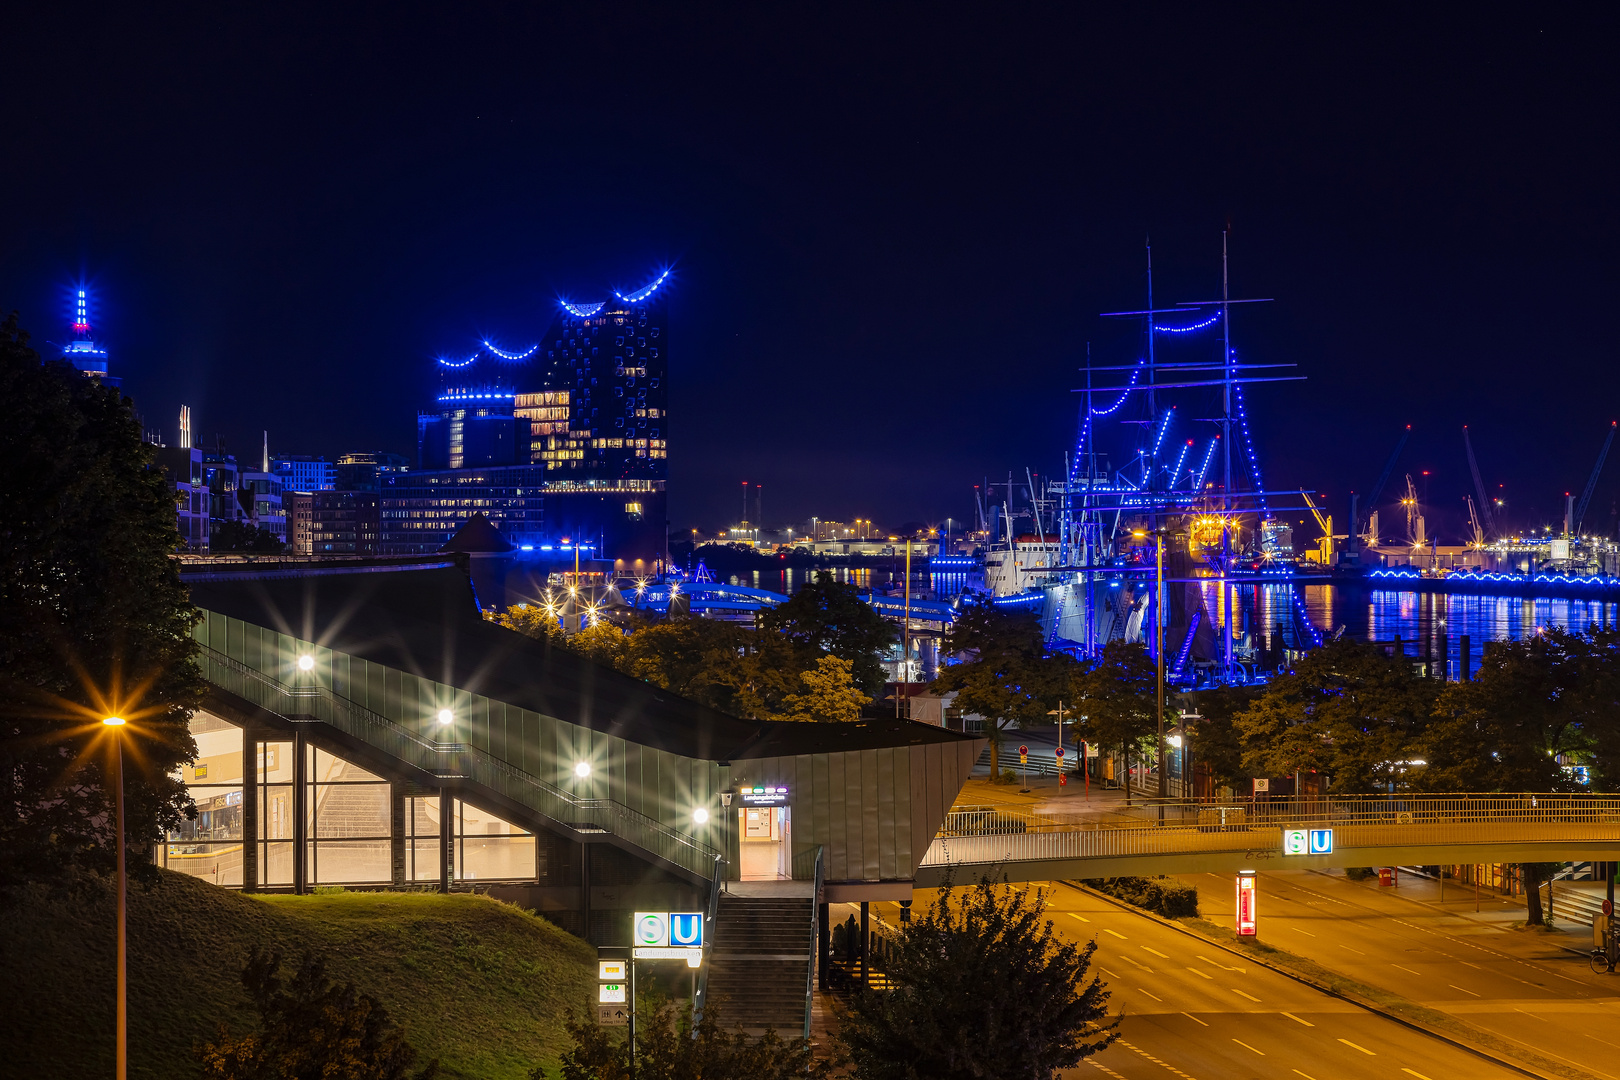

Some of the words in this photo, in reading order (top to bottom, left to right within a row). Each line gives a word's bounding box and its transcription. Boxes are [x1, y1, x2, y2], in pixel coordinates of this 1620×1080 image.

[1288, 832, 1305, 852] S
[1313, 832, 1330, 852] U
[639, 916, 664, 943] S
[674, 916, 698, 943] U
